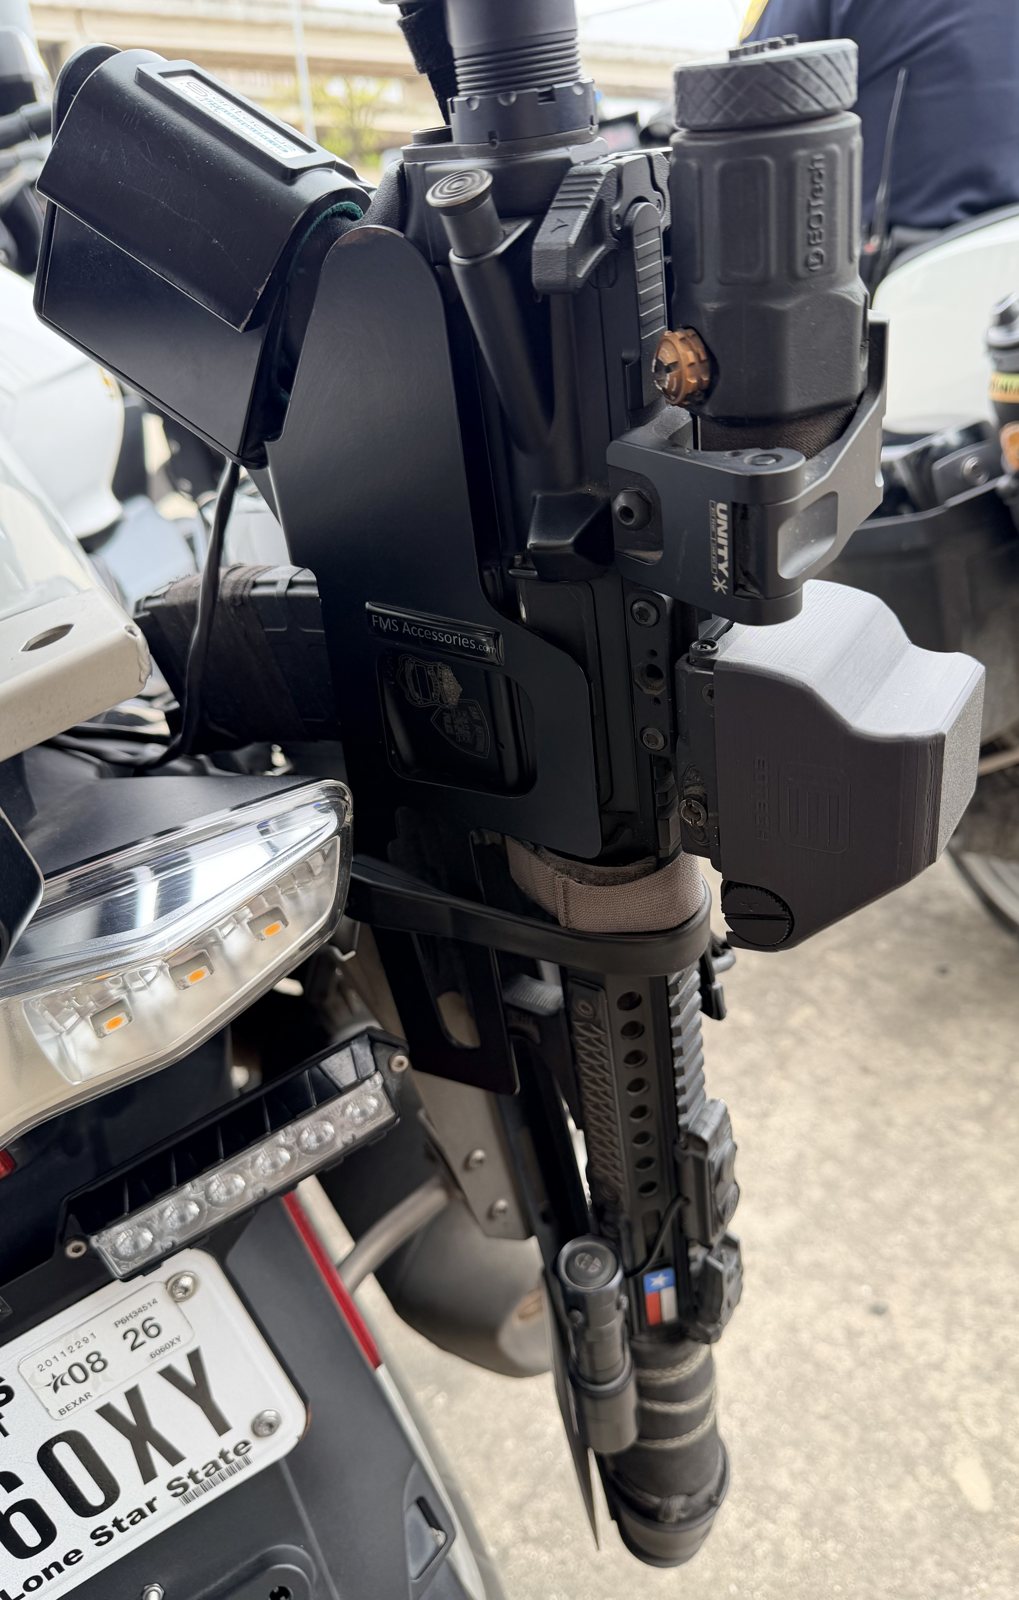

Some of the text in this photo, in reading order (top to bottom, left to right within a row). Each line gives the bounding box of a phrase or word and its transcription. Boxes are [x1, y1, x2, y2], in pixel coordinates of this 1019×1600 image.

[716, 502, 729, 577] UNITY
[371, 614, 399, 632] FMS
[37, 1332, 97, 1372] 20112291
[68, 1316, 162, 1384] 08 26
[58, 1391, 93, 1416] BEXAR
[0, 1438, 252, 1600] Lone Star State
